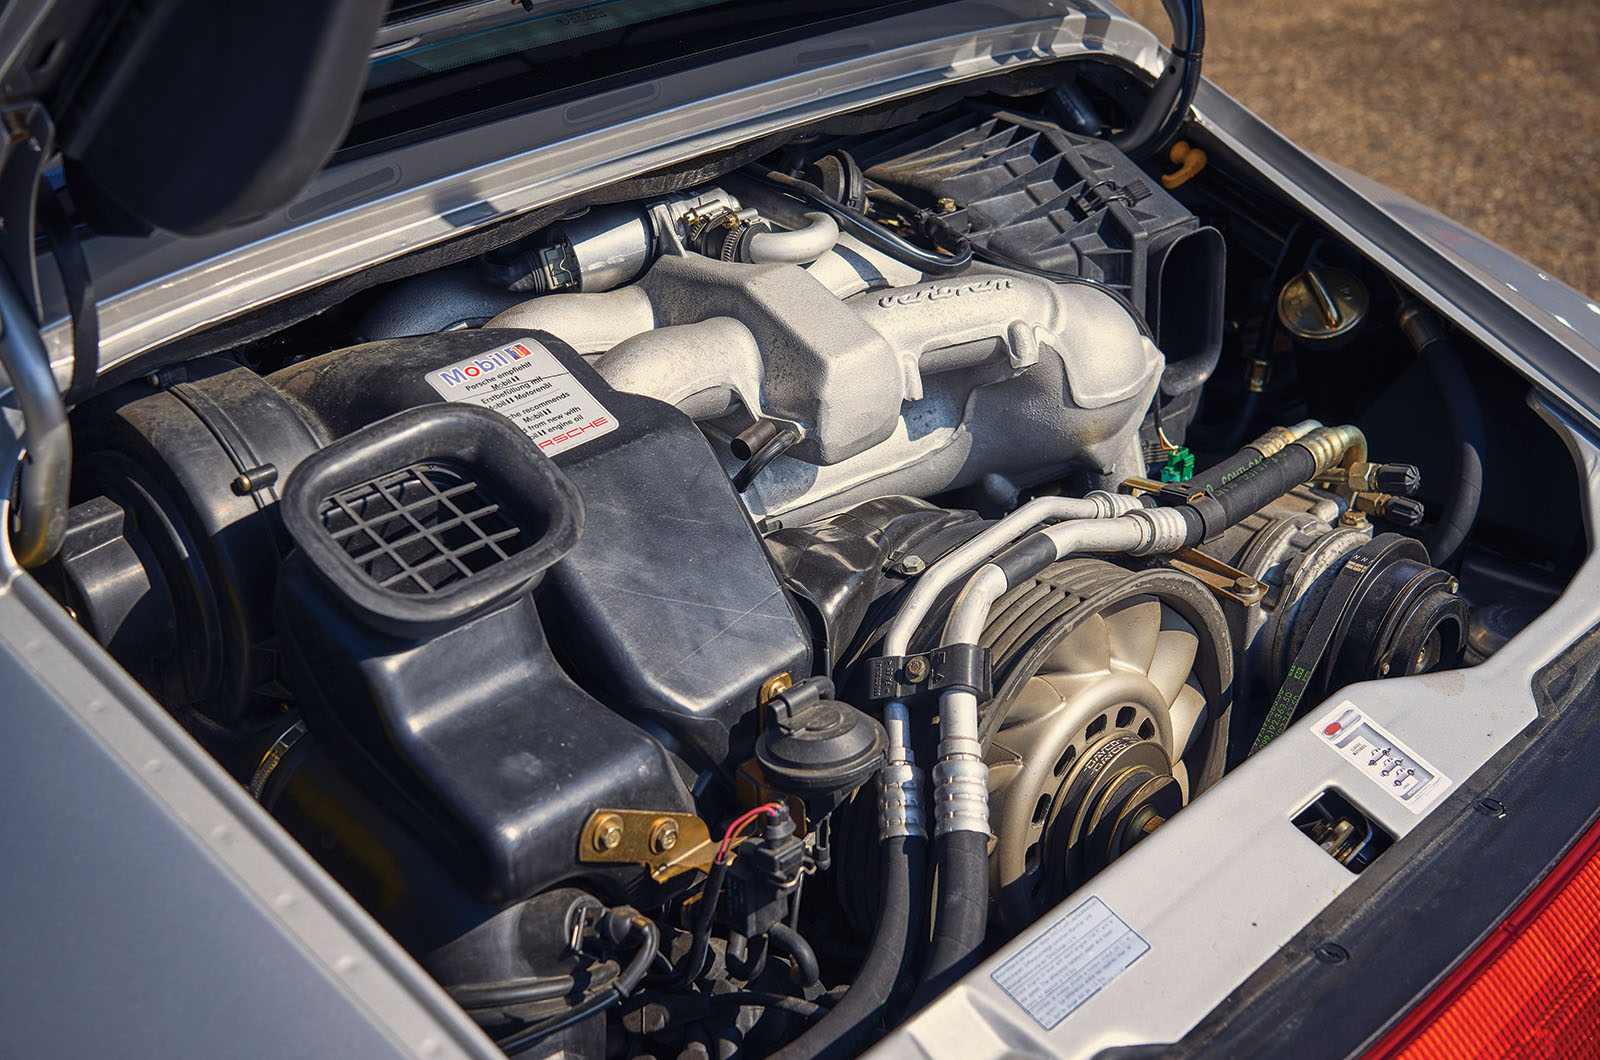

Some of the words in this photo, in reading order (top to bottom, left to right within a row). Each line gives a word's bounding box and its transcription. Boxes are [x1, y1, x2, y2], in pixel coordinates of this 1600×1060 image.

[440, 352, 509, 386] Mobil
[465, 375, 497, 392] Porsche
[498, 361, 532, 379] empfiehlt
[481, 382, 530, 405] Erstbefüllung
[531, 376, 543, 386] mit
[514, 382, 553, 401] Motorenöl
[522, 392, 570, 414] recommends
[528, 419, 547, 431] from
[547, 414, 564, 424] new
[564, 406, 582, 417] with
[538, 416, 609, 450] RSCHE
[547, 420, 574, 434] engine
[574, 414, 585, 423] oil
[1085, 739, 1121, 769] DAYCO
